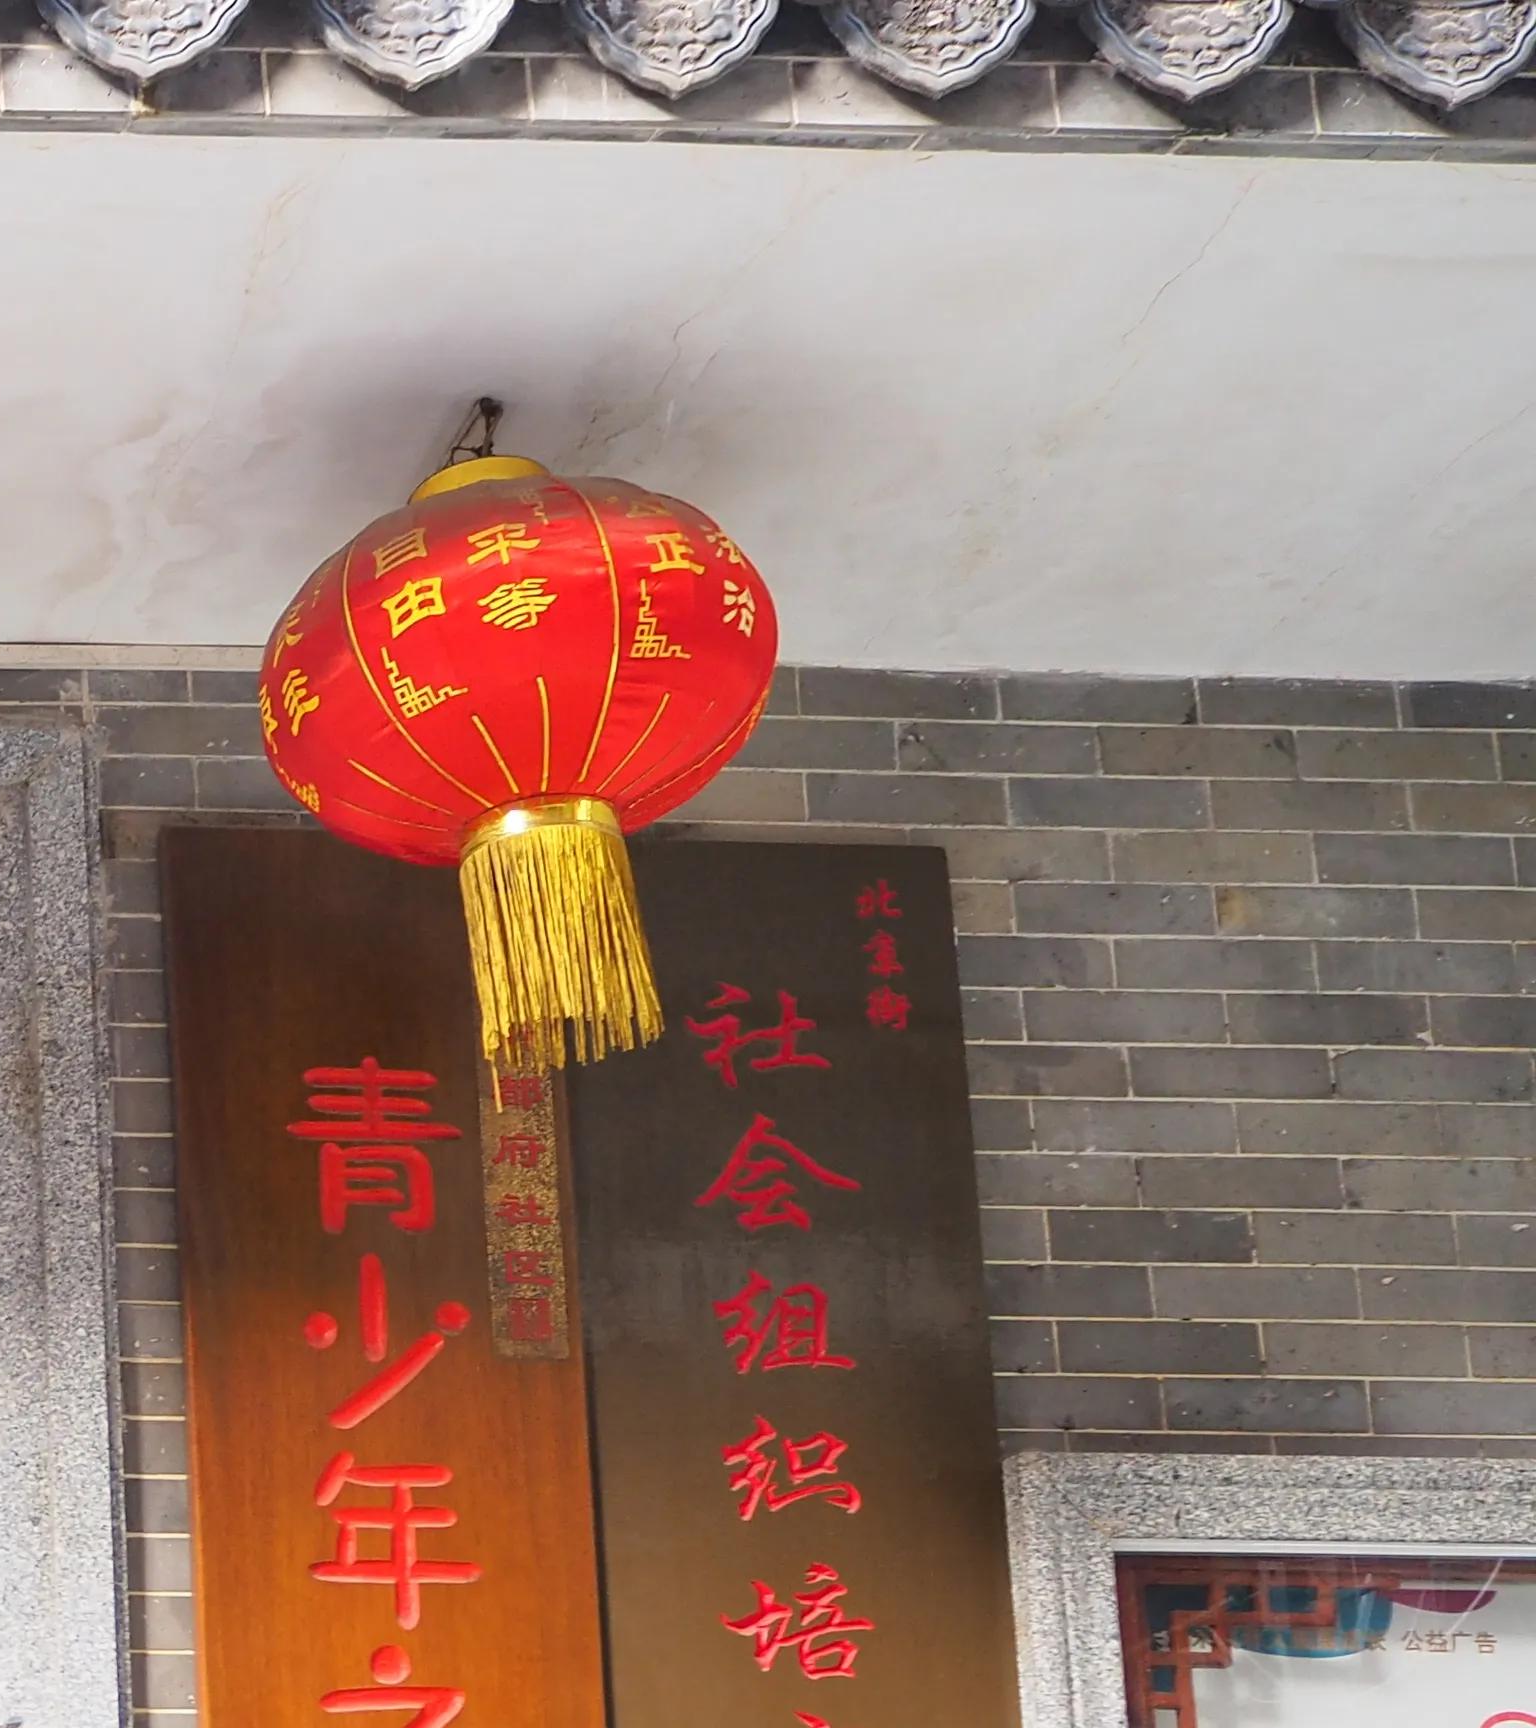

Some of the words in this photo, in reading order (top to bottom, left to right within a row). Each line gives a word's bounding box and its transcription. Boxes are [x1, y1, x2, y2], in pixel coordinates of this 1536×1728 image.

[373, 528, 447, 639] 自由
[466, 523, 558, 632] 平等
[856, 879, 913, 1031] 北京街
[1401, 1629, 1499, 1655] 公益广告
